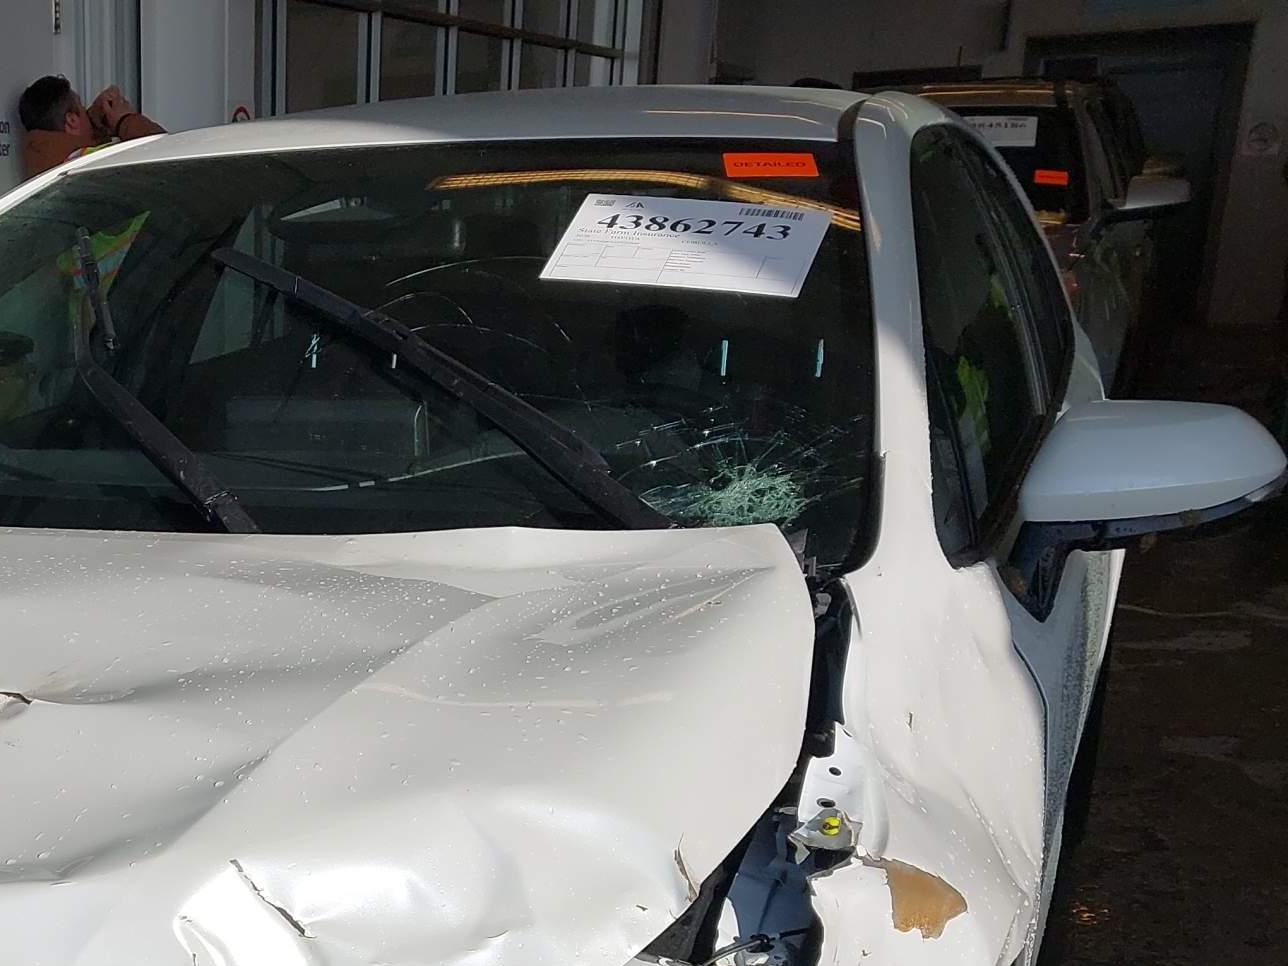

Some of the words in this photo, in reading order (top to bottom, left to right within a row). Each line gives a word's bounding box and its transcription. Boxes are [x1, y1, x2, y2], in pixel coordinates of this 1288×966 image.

[732, 160, 807, 168] DETAILED
[597, 213, 792, 241] 43862743
[604, 228, 631, 236] Farm
[632, 230, 681, 239] Insurance
